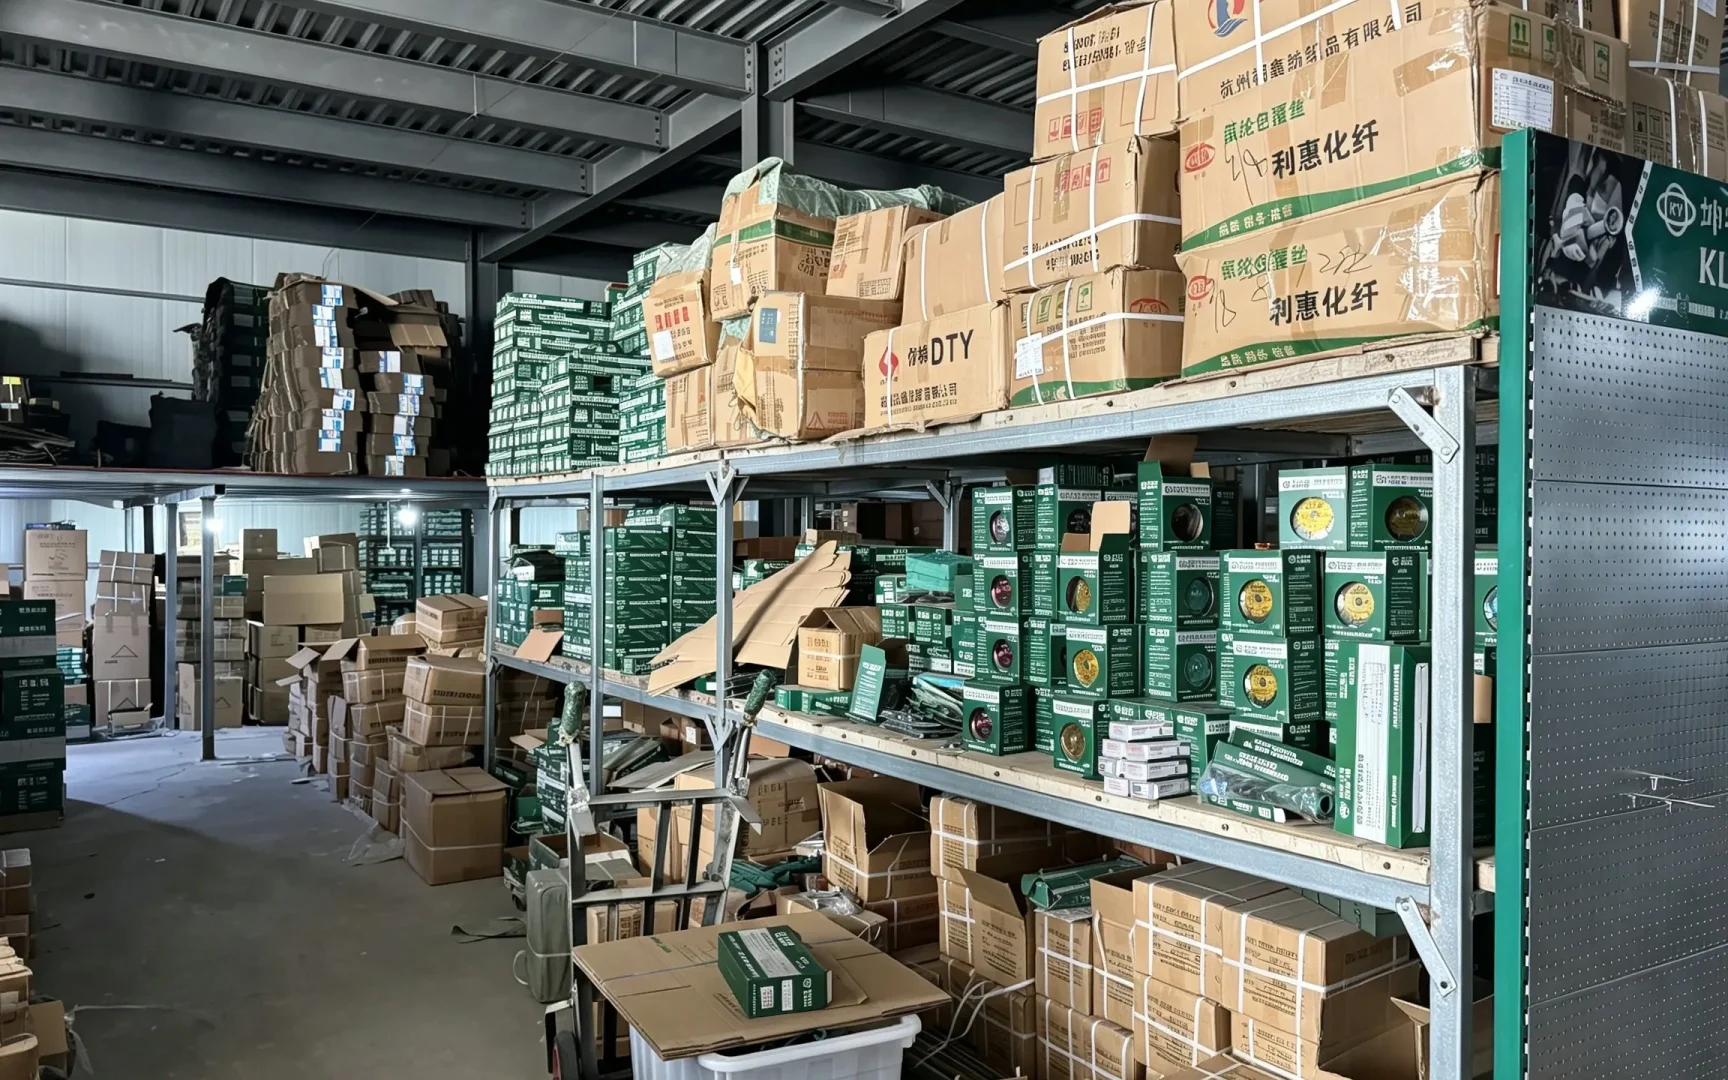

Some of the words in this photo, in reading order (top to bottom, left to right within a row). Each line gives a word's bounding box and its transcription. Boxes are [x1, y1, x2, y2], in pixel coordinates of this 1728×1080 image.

[1272, 119, 1380, 179] 利惠化纤
[1269, 280, 1380, 326] 利惠化纤
[931, 329, 974, 366] DTY
